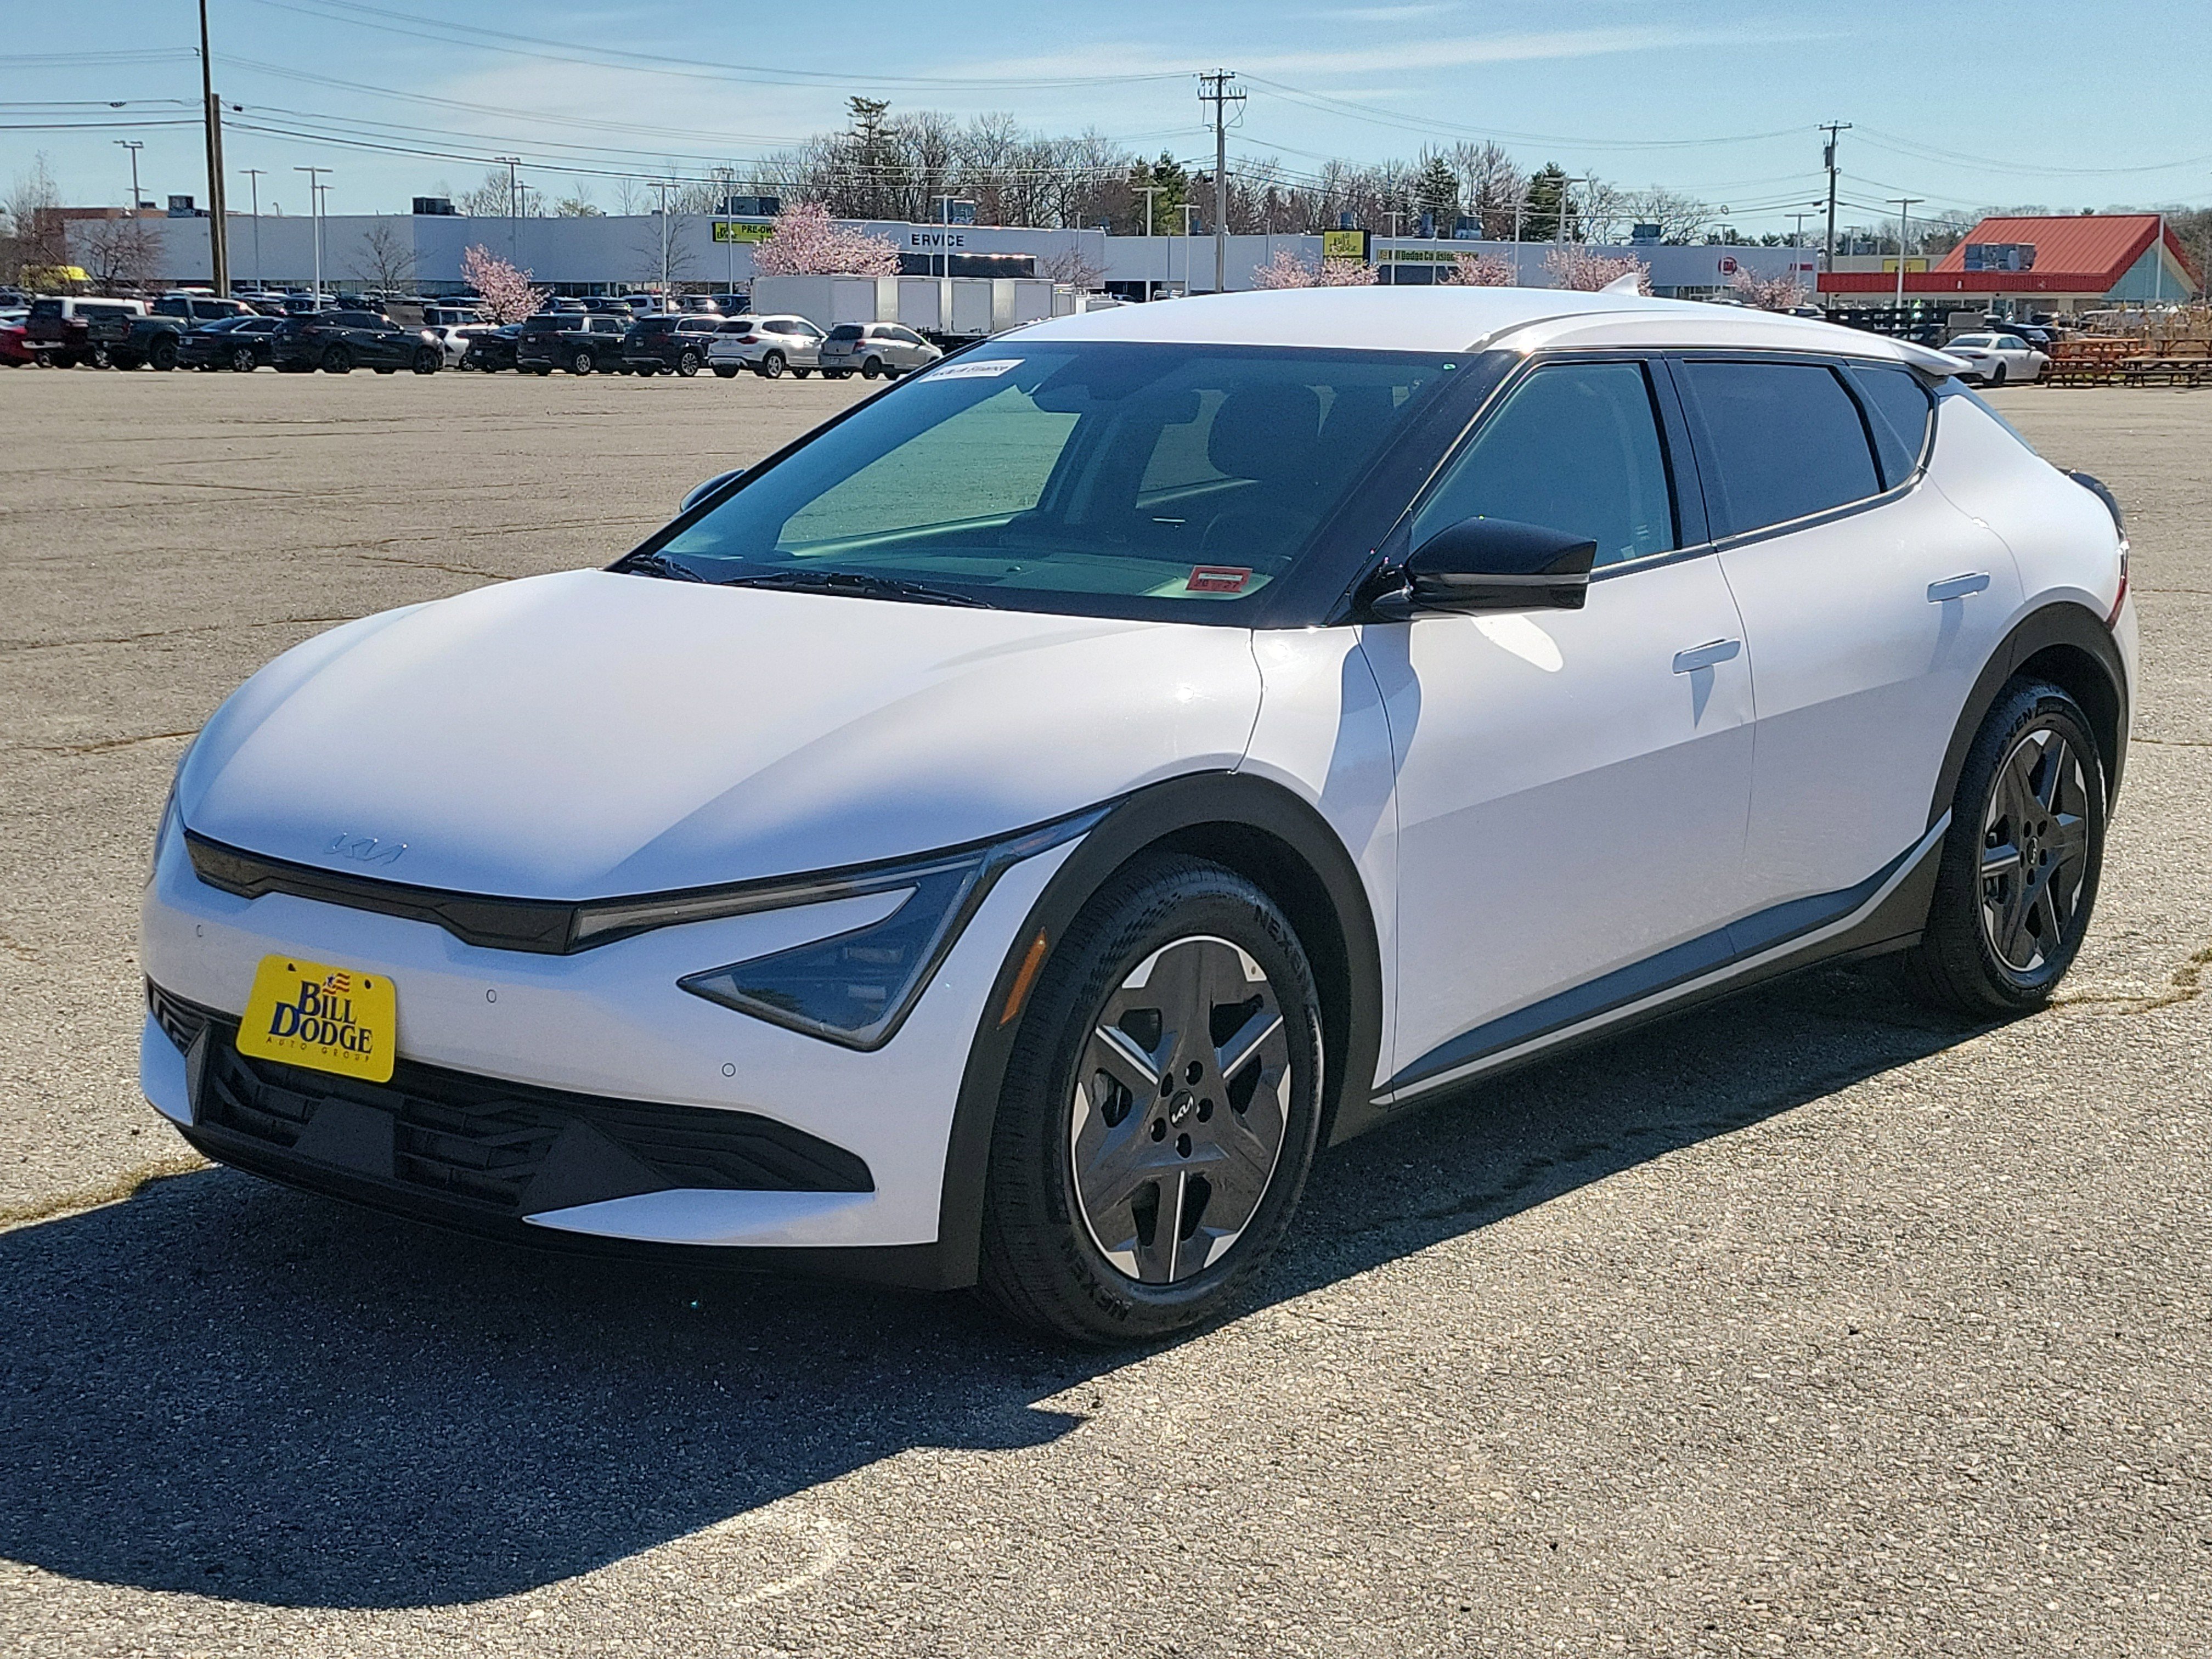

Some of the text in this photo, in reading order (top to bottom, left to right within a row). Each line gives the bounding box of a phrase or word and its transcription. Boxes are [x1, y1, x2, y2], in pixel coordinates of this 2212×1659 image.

[911, 234, 964, 247] ERVICE
[298, 980, 357, 1025] BILL
[268, 1001, 374, 1054] DODGE
[266, 1036, 307, 1051] AUTO
